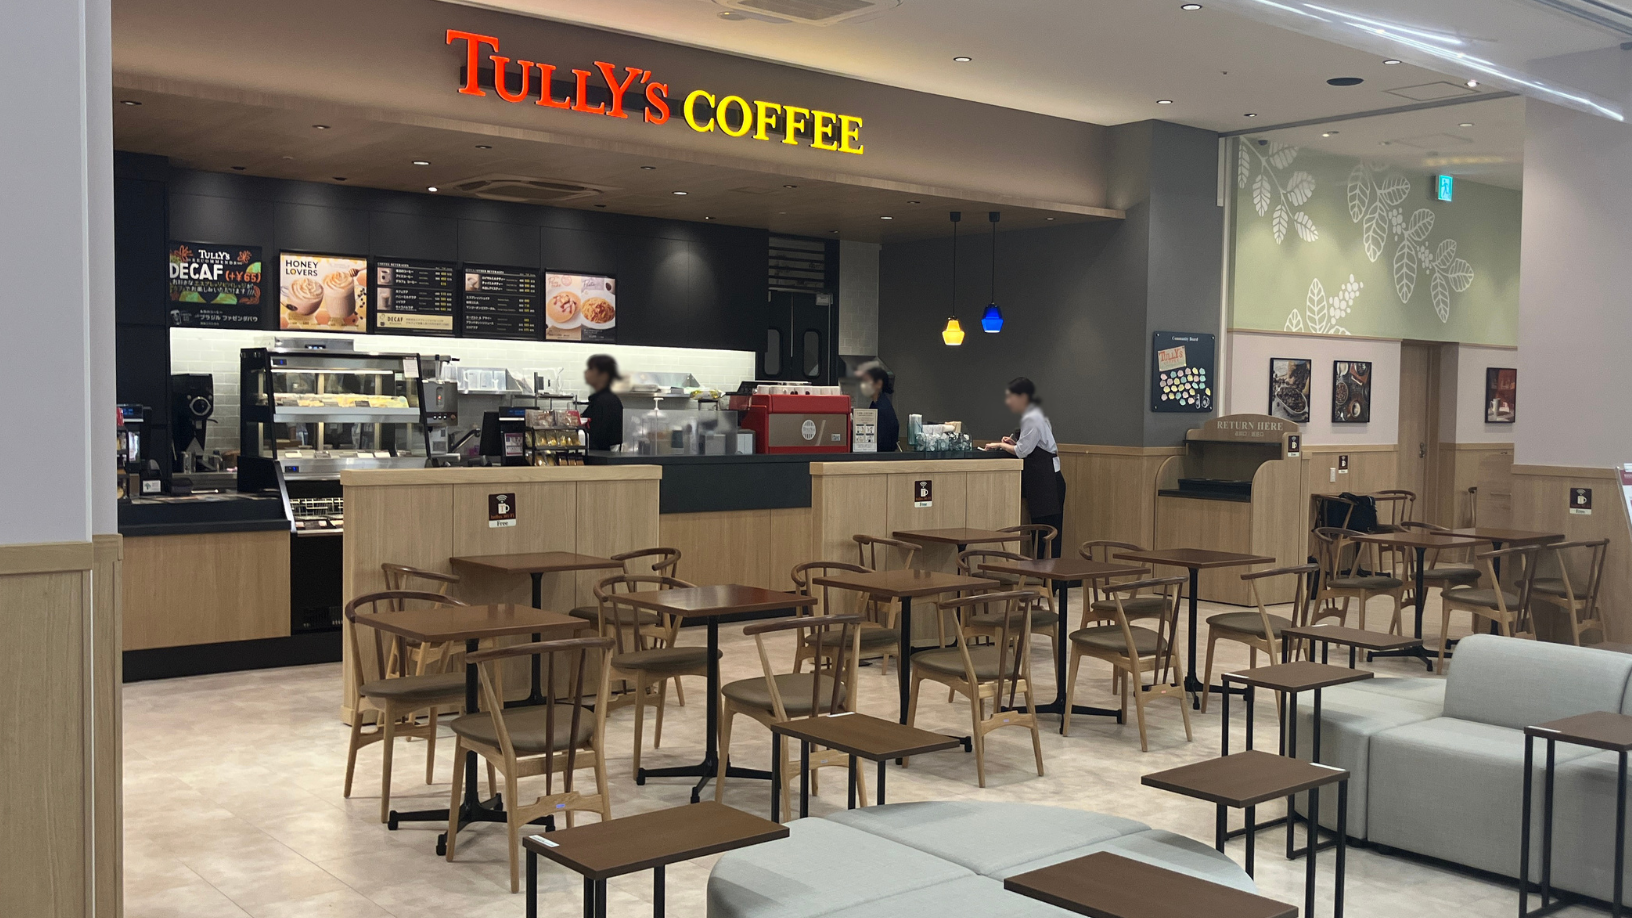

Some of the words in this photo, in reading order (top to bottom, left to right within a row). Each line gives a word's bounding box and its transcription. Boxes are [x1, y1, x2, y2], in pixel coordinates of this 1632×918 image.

[446, 28, 669, 125] TULLY'S
[683, 89, 864, 155] COFFEE
[285, 260, 318, 269] HONEY
[169, 262, 223, 280] DECAF
[285, 268, 318, 277] LOVERS
[1217, 420, 1254, 430] RETURN
[1257, 421, 1283, 431] HERE
